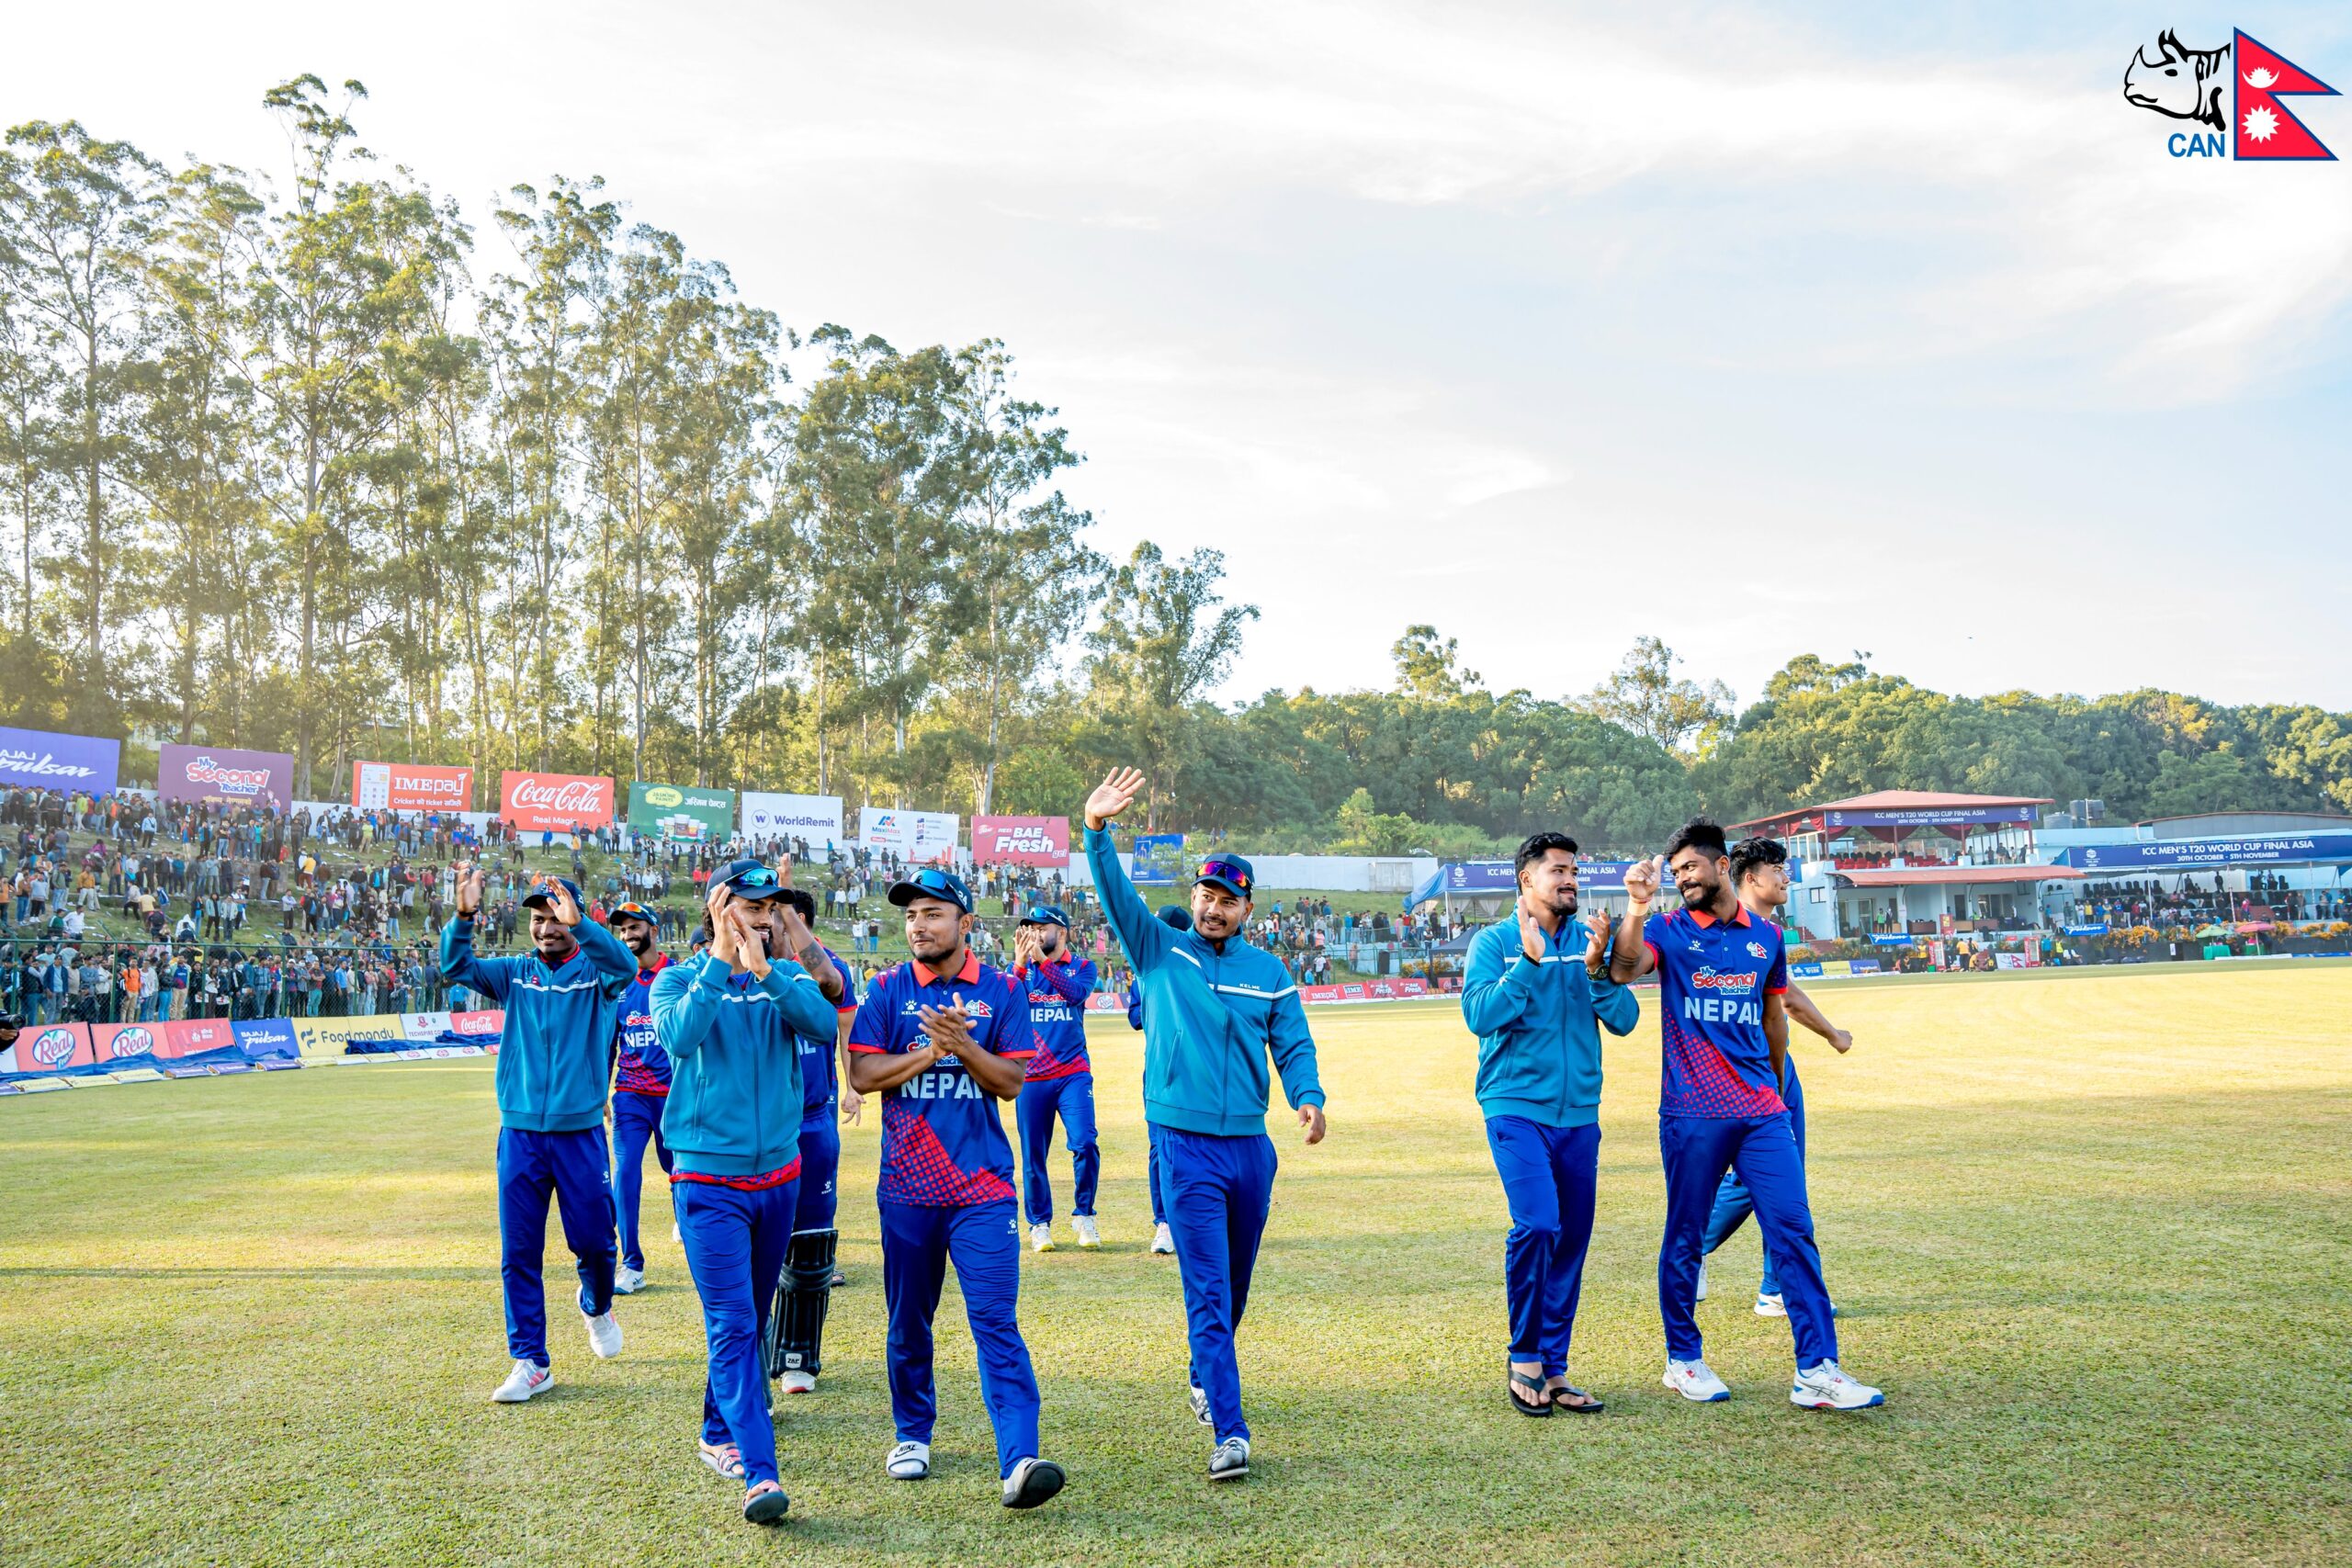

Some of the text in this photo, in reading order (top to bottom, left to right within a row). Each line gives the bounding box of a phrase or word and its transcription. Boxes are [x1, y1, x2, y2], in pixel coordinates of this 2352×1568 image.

[0, 749, 36, 761] AJAJ
[198, 757, 218, 770] My
[187, 761, 270, 787] Second
[220, 783, 258, 795] Teacher
[511, 779, 605, 813] Coca-Cola
[533, 816, 551, 824] Real
[774, 816, 834, 827] WorldRemit
[1013, 827, 1043, 839] BAE
[994, 836, 1055, 853] Fresh
[2143, 840, 2314, 855] ICC MEN'S T20 WORLD CUP FINAL ASIA
[1700, 965, 1716, 977] My
[1692, 971, 1757, 988] Second
[1720, 987, 1750, 995] Teacher
[1684, 997, 1760, 1026] NEPAL
[118, 1029, 149, 1056] Real
[321, 1028, 394, 1043] Foodmandu
[625, 1031, 661, 1047] NEP
[915, 1034, 933, 1046] My
[40, 1029, 72, 1066] Real
[900, 1073, 983, 1099] NEPAL
[899, 1444, 916, 1453] NIKE
